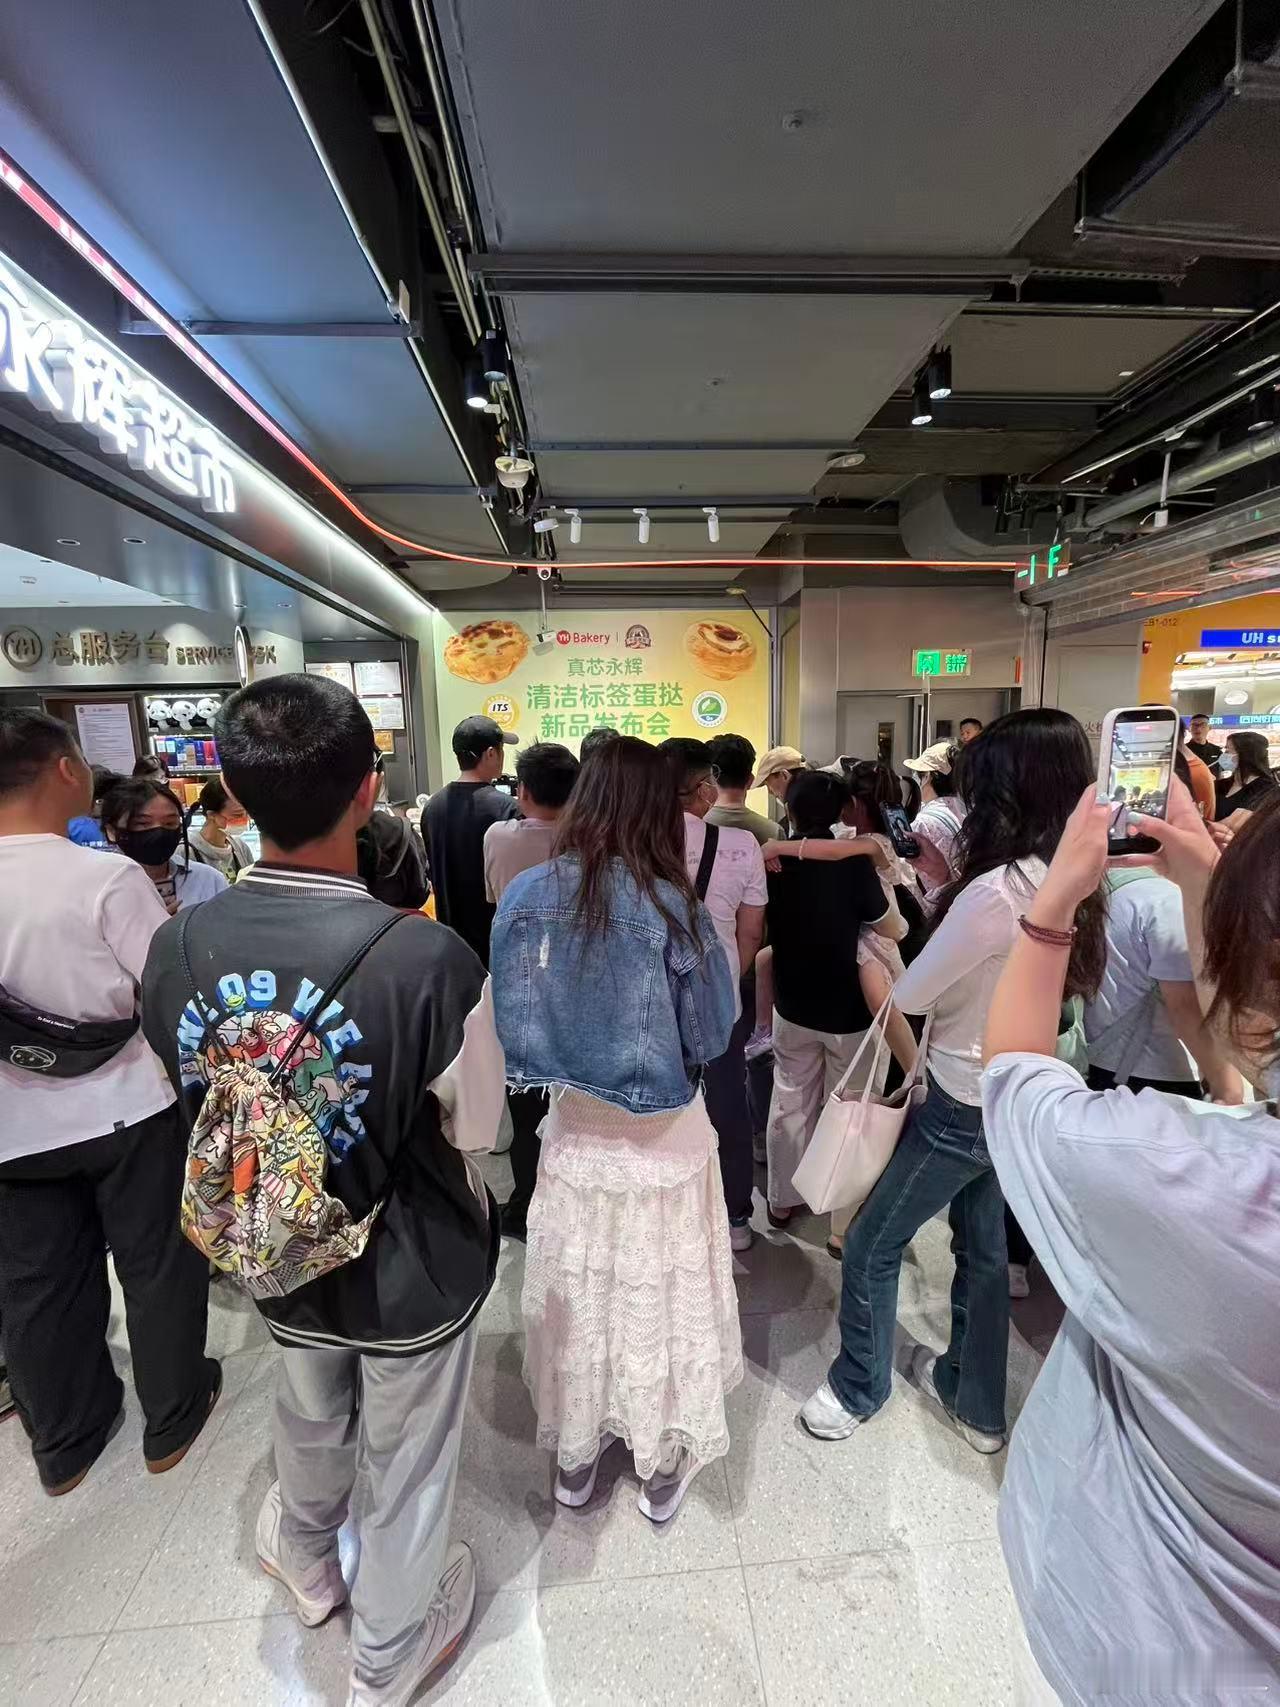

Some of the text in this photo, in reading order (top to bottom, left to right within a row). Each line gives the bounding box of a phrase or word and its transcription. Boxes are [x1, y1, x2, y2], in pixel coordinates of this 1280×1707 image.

[573, 632, 610, 644] Bakery
[1242, 632, 1264, 643] UH
[52, 629, 169, 666] 总服务台
[176, 646, 234, 664] SERVICE
[567, 658, 643, 677] 真芯永辉
[946, 664, 965, 672] EXIT
[527, 682, 683, 709] 清洁标签蛋挞
